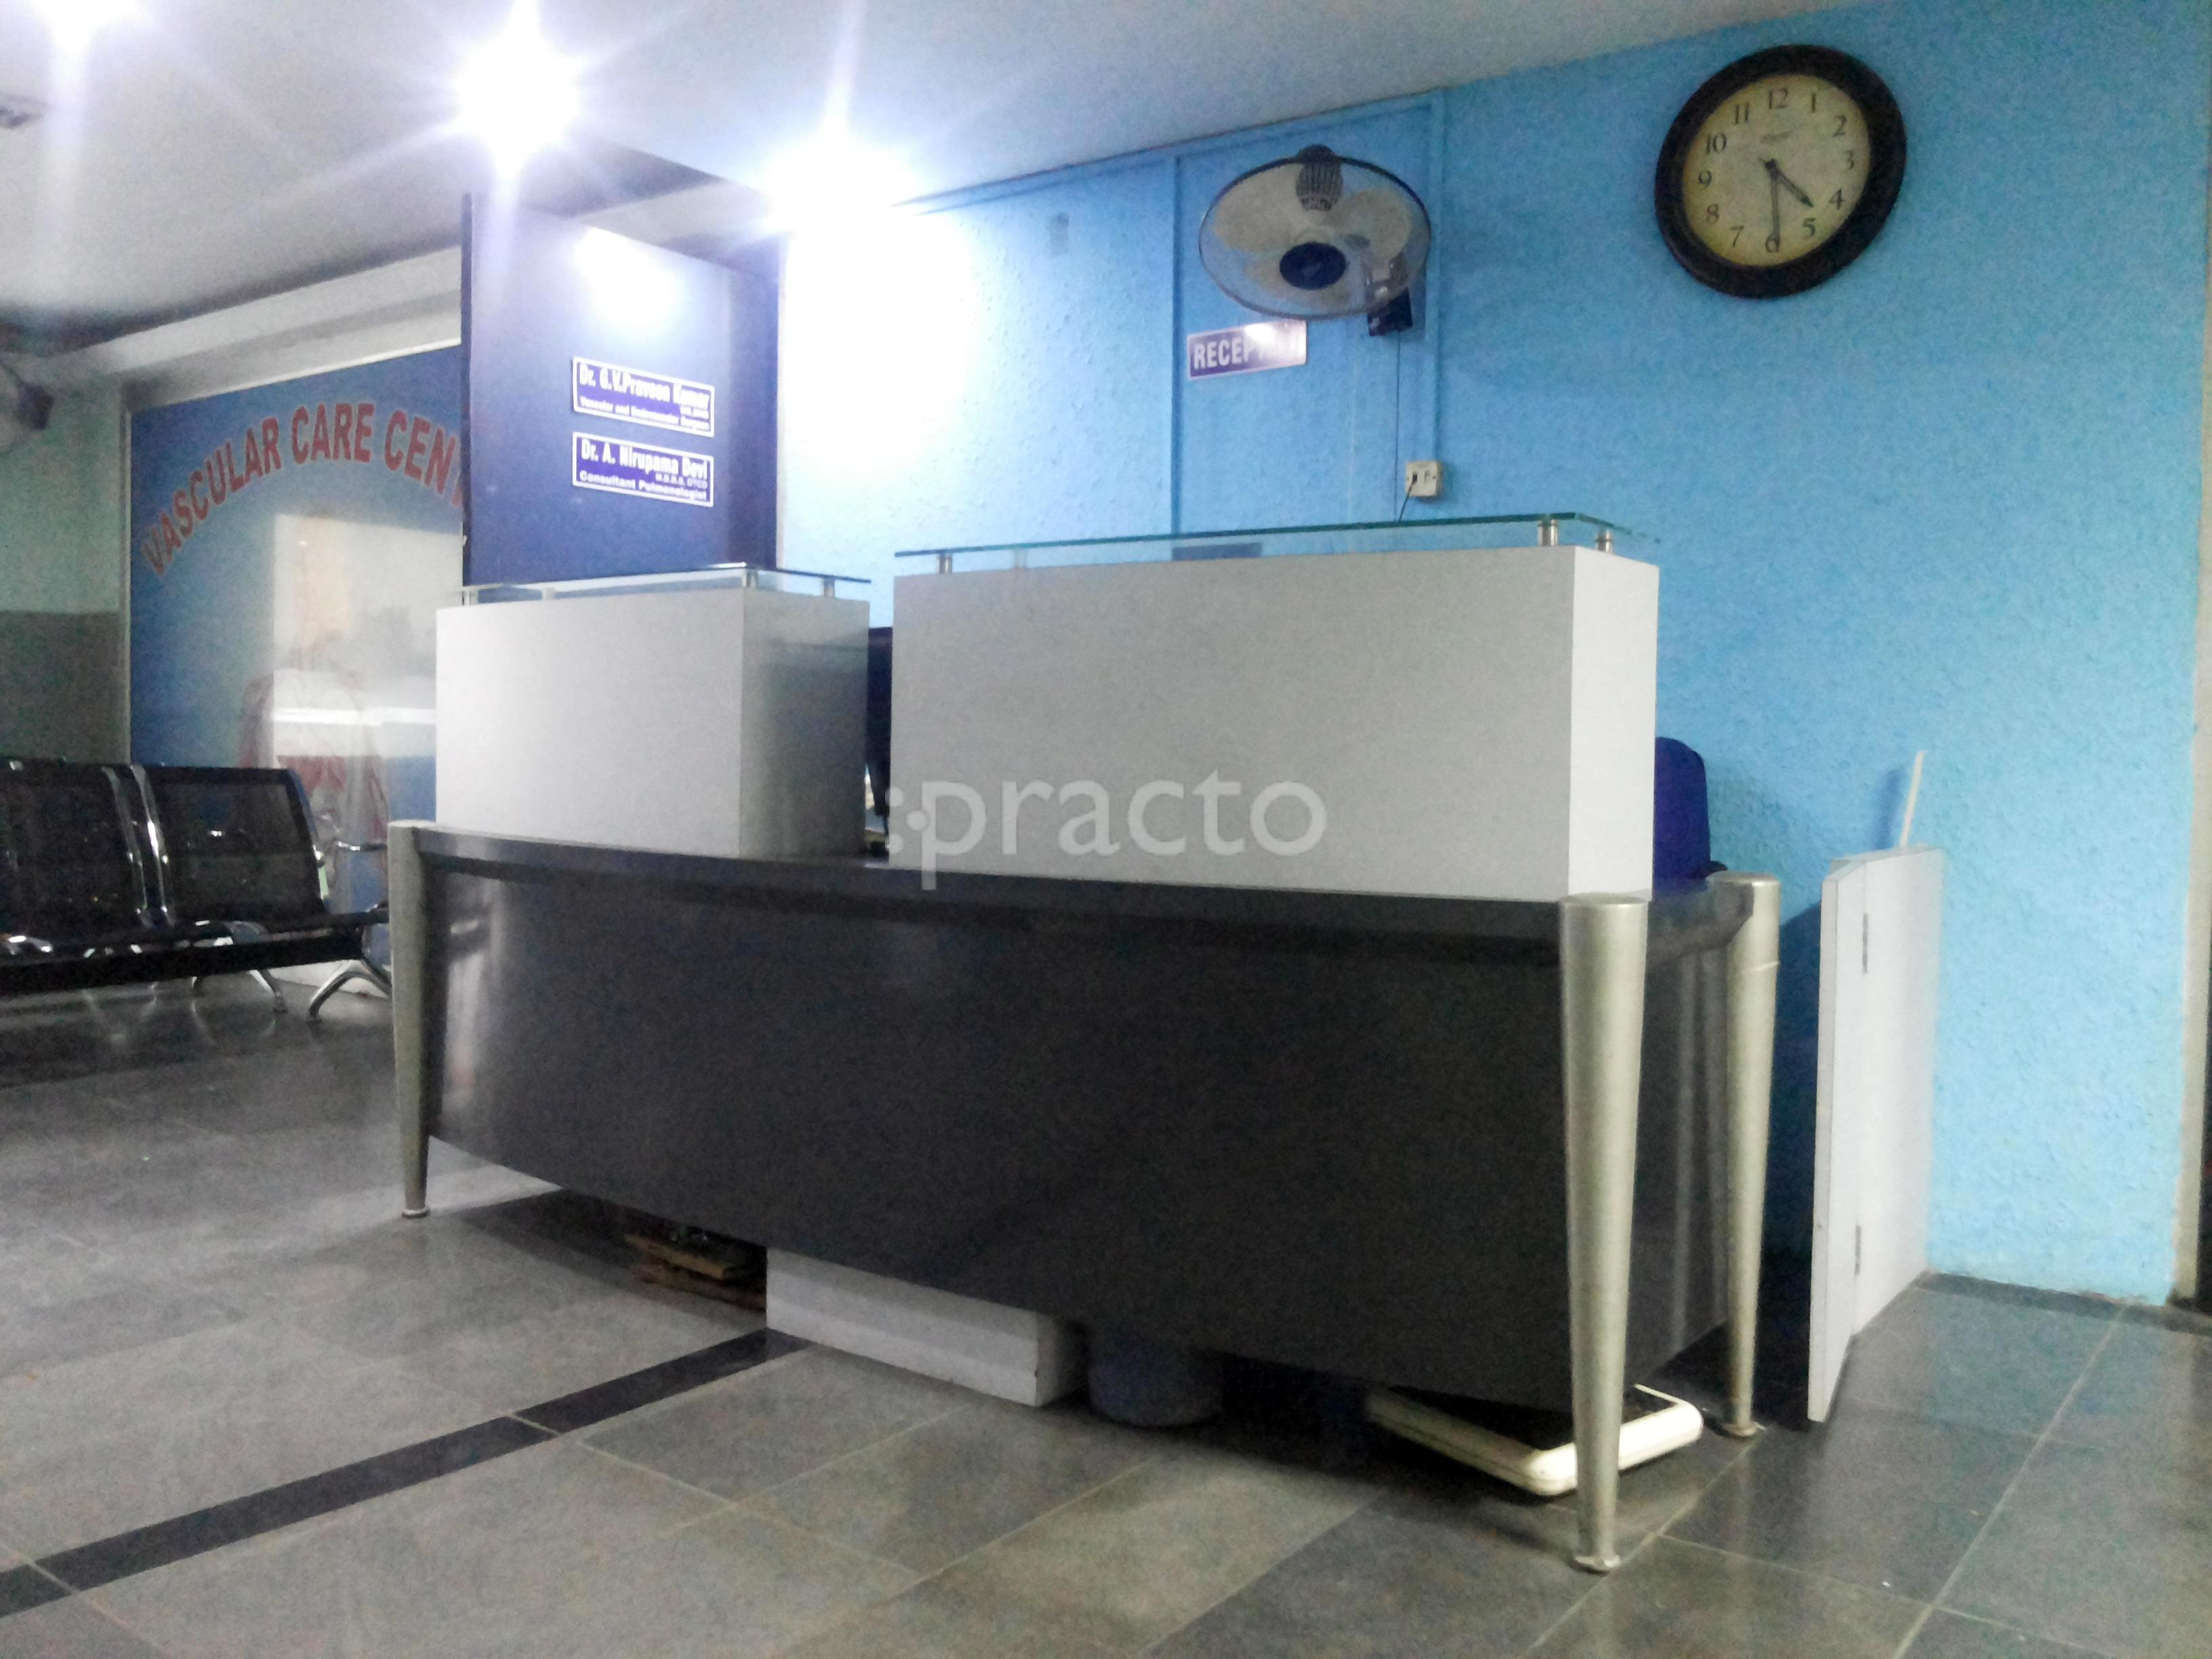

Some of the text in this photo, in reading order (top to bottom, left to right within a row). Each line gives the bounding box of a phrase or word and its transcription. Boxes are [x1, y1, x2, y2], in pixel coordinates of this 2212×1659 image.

[1767, 87, 1789, 110] 12
[1810, 92, 1818, 113] 1
[1732, 102, 1750, 125] 11
[1832, 115, 1847, 136] 2
[1704, 132, 1727, 155] 10
[1843, 150, 1855, 170] 3
[1698, 170, 1713, 188] 9
[1828, 188, 1846, 210] 4
[1705, 203, 1720, 224] 8
[1729, 225, 1744, 247] 7
[1803, 218, 1816, 239] 5
[581, 438, 598, 462] Dr.
[602, 442, 616, 464] A.
[141, 401, 463, 576] VASCULAR CARE CEN
